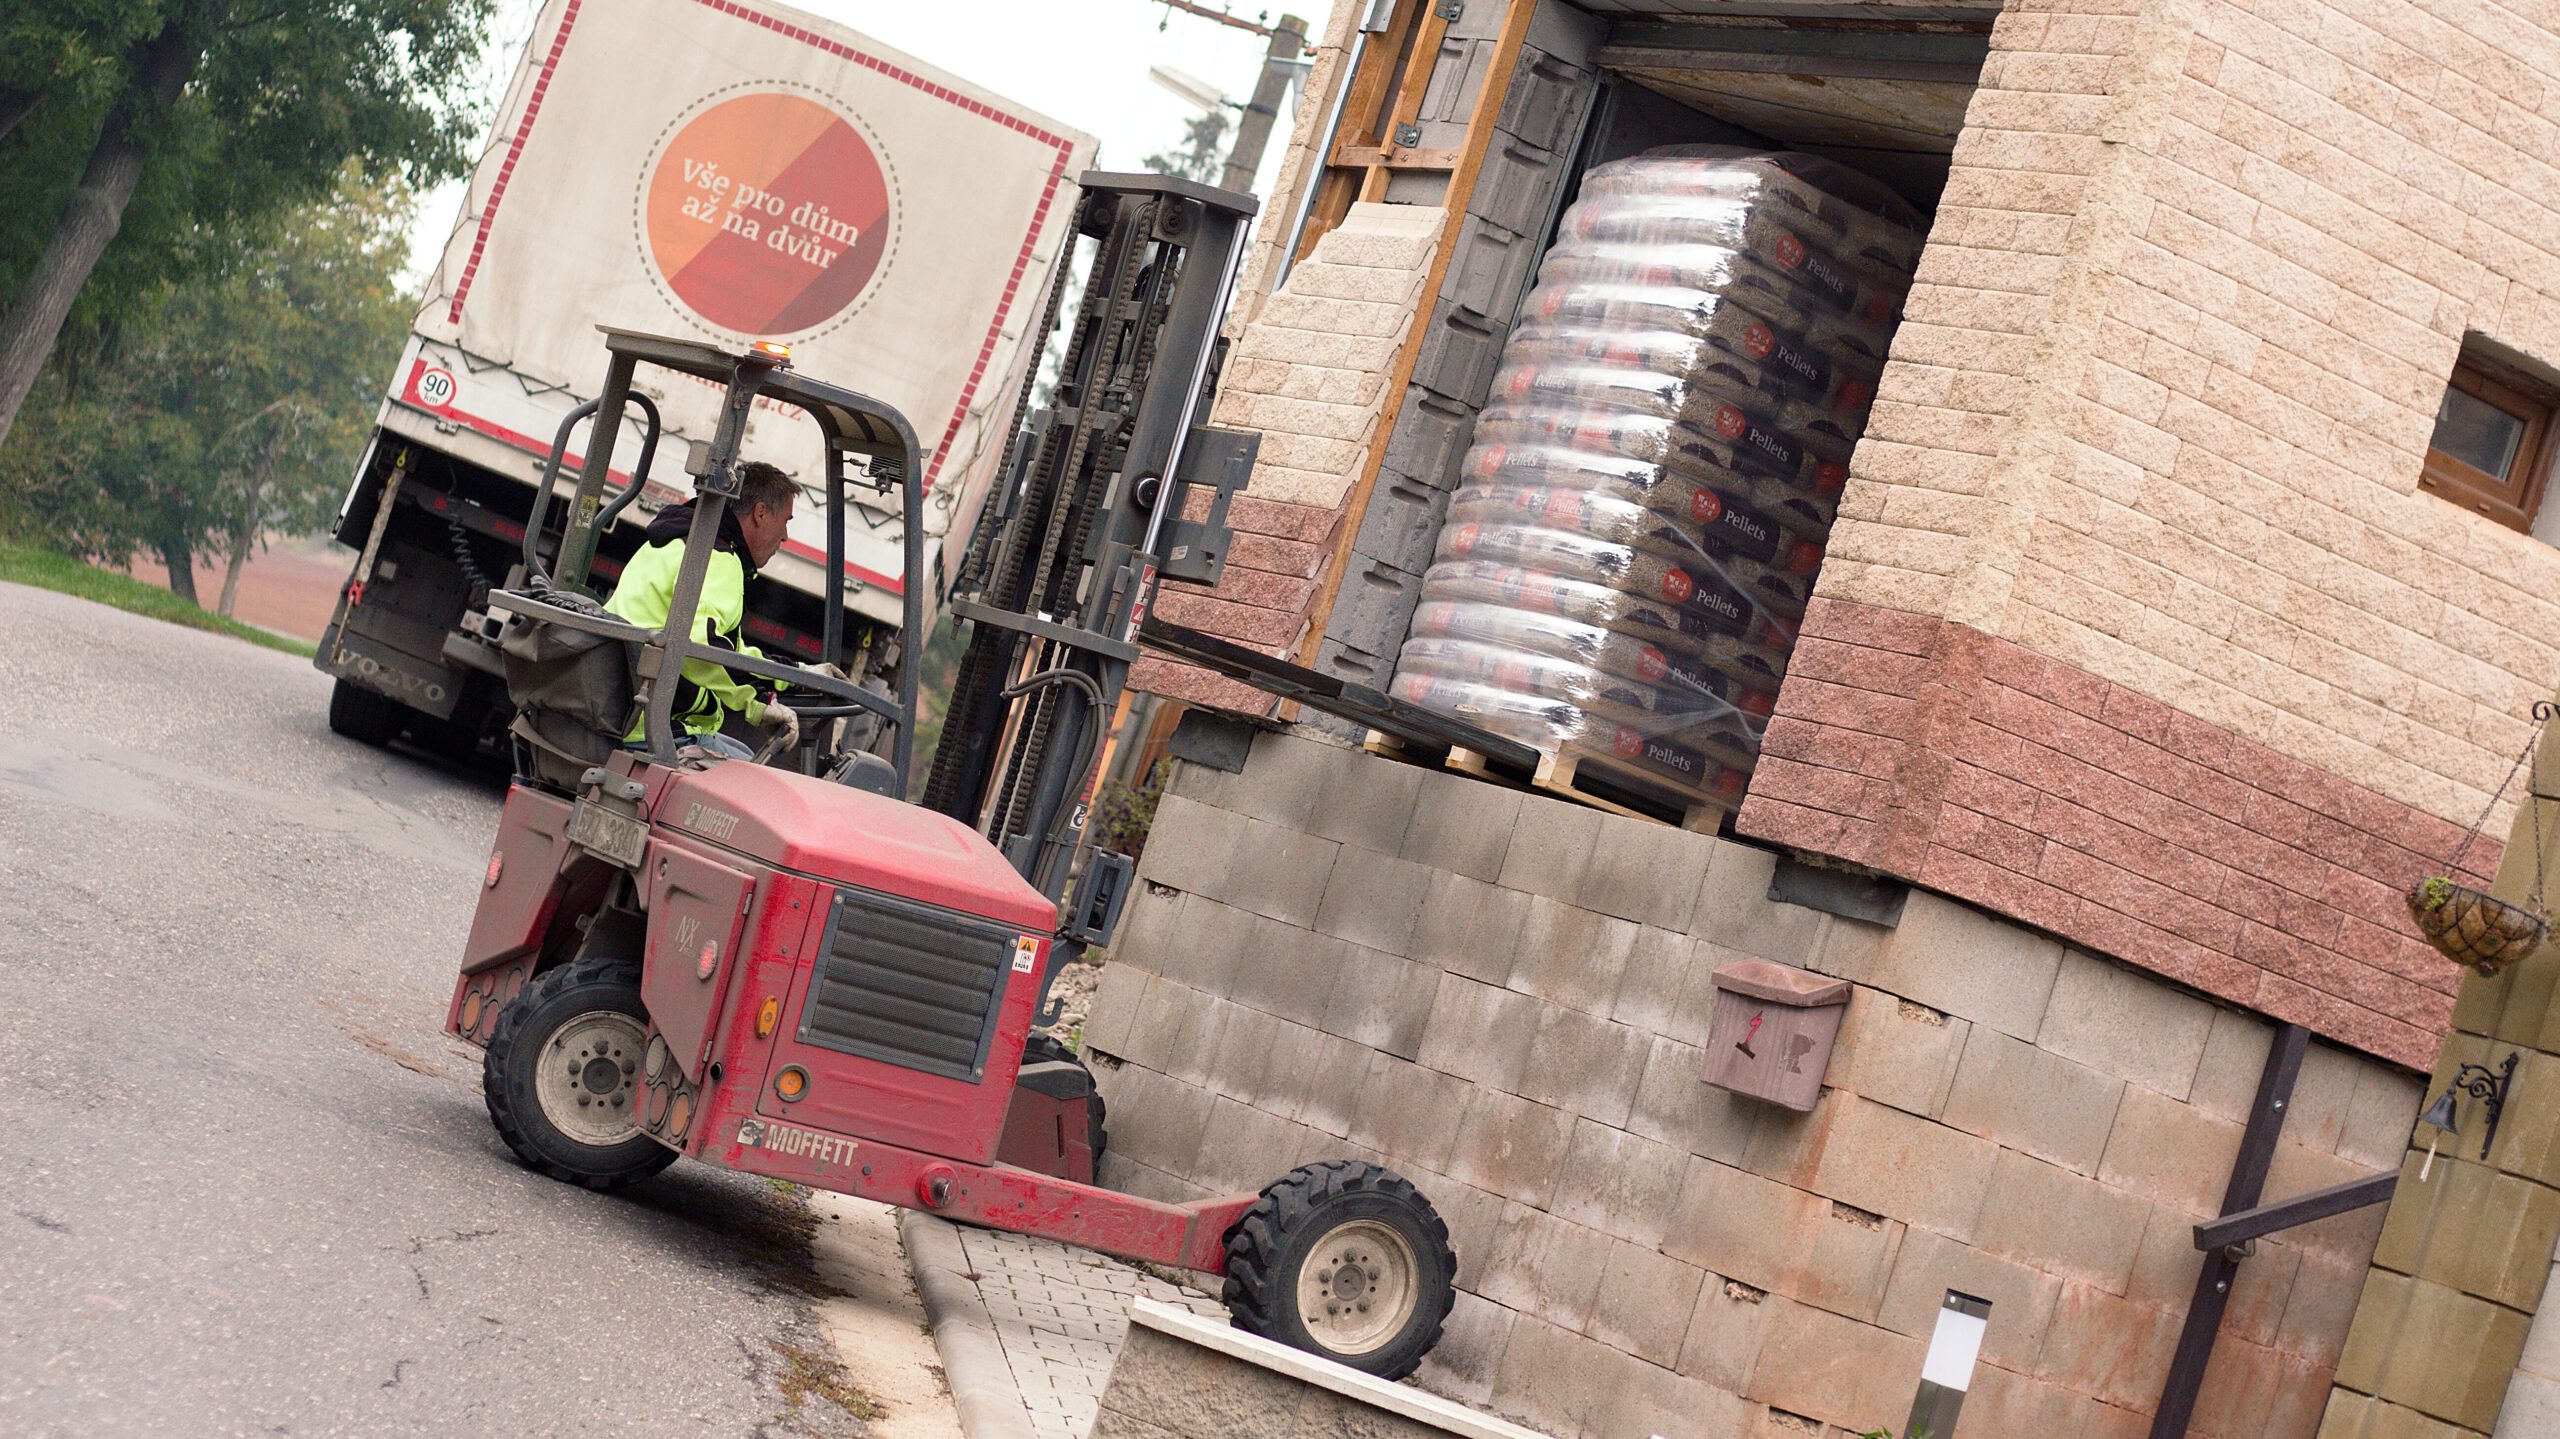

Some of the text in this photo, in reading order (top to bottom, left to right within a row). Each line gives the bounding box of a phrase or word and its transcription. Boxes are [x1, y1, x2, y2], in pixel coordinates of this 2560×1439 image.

[683, 157, 859, 248] Vše pro dům
[681, 196, 838, 269] až na dvůr
[1807, 257, 1845, 293] Pellets
[1777, 345, 1818, 381] Pellets
[423, 391, 439, 405] km
[424, 374, 449, 397] 90
[1505, 452, 1538, 468] Pellets
[1749, 427, 1790, 463] Pellets
[1724, 509, 1767, 542] Pellets
[1696, 588, 1740, 620] Pellets
[335, 648, 446, 702] VOLVO
[1648, 743, 1692, 773] Pellets
[695, 805, 740, 840] MOFFETT
[765, 1124, 859, 1168] MOFFETT
